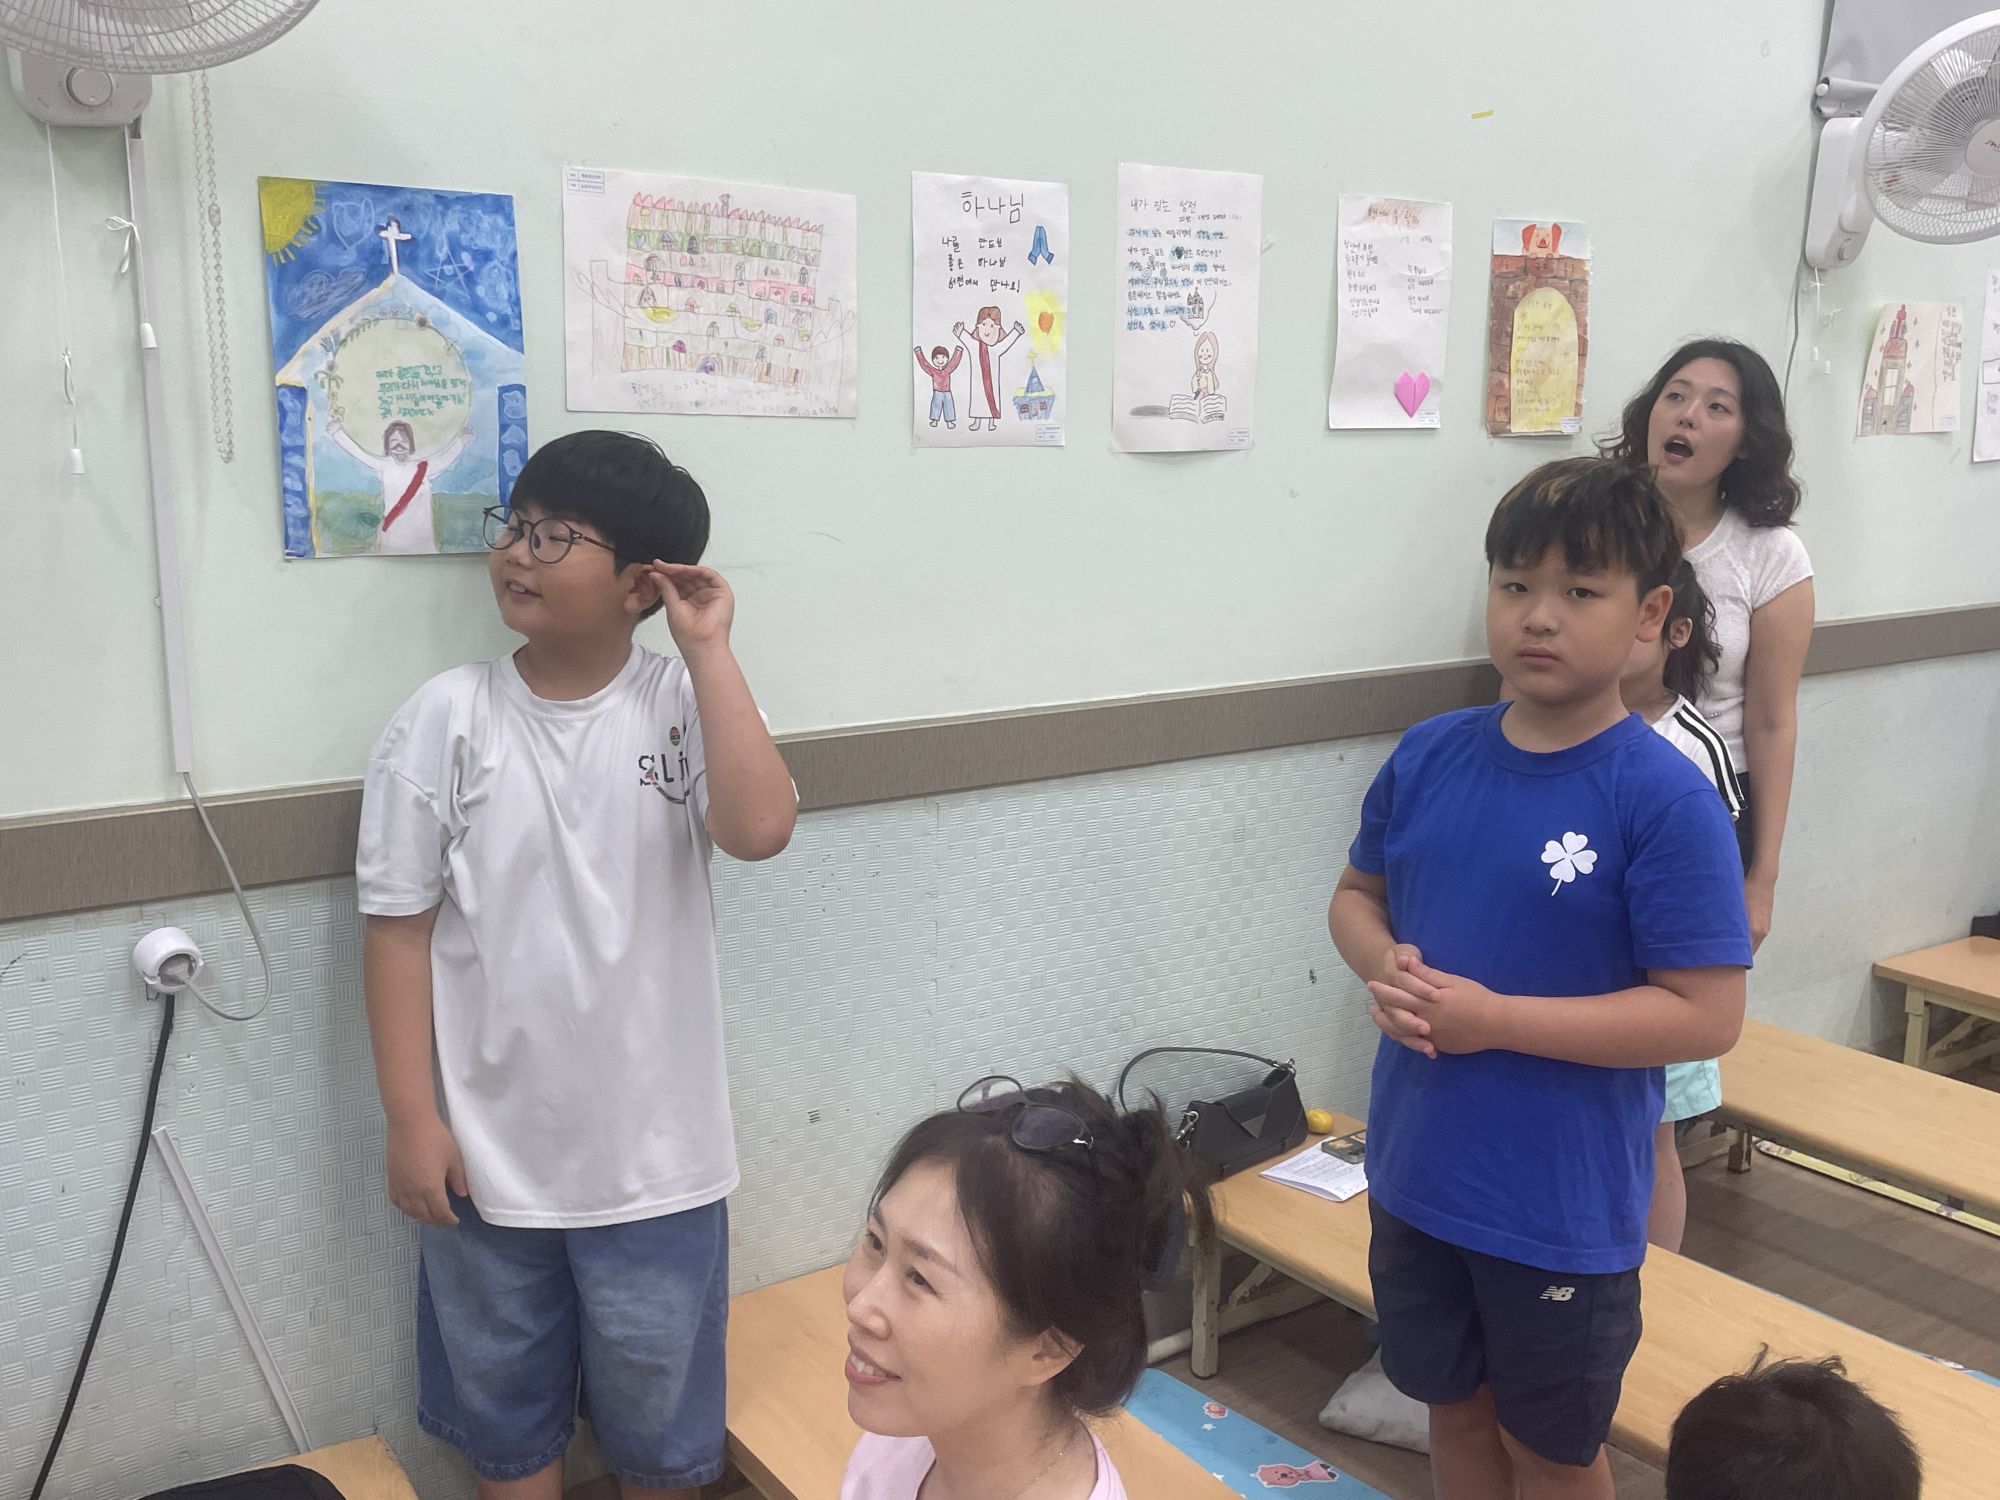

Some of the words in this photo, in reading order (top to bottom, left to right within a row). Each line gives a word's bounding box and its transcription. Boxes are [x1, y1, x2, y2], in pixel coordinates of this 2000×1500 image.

[961, 192, 1024, 224] 하나님
[942, 236, 960, 252] 나를
[978, 257, 1006, 268] 하나님
